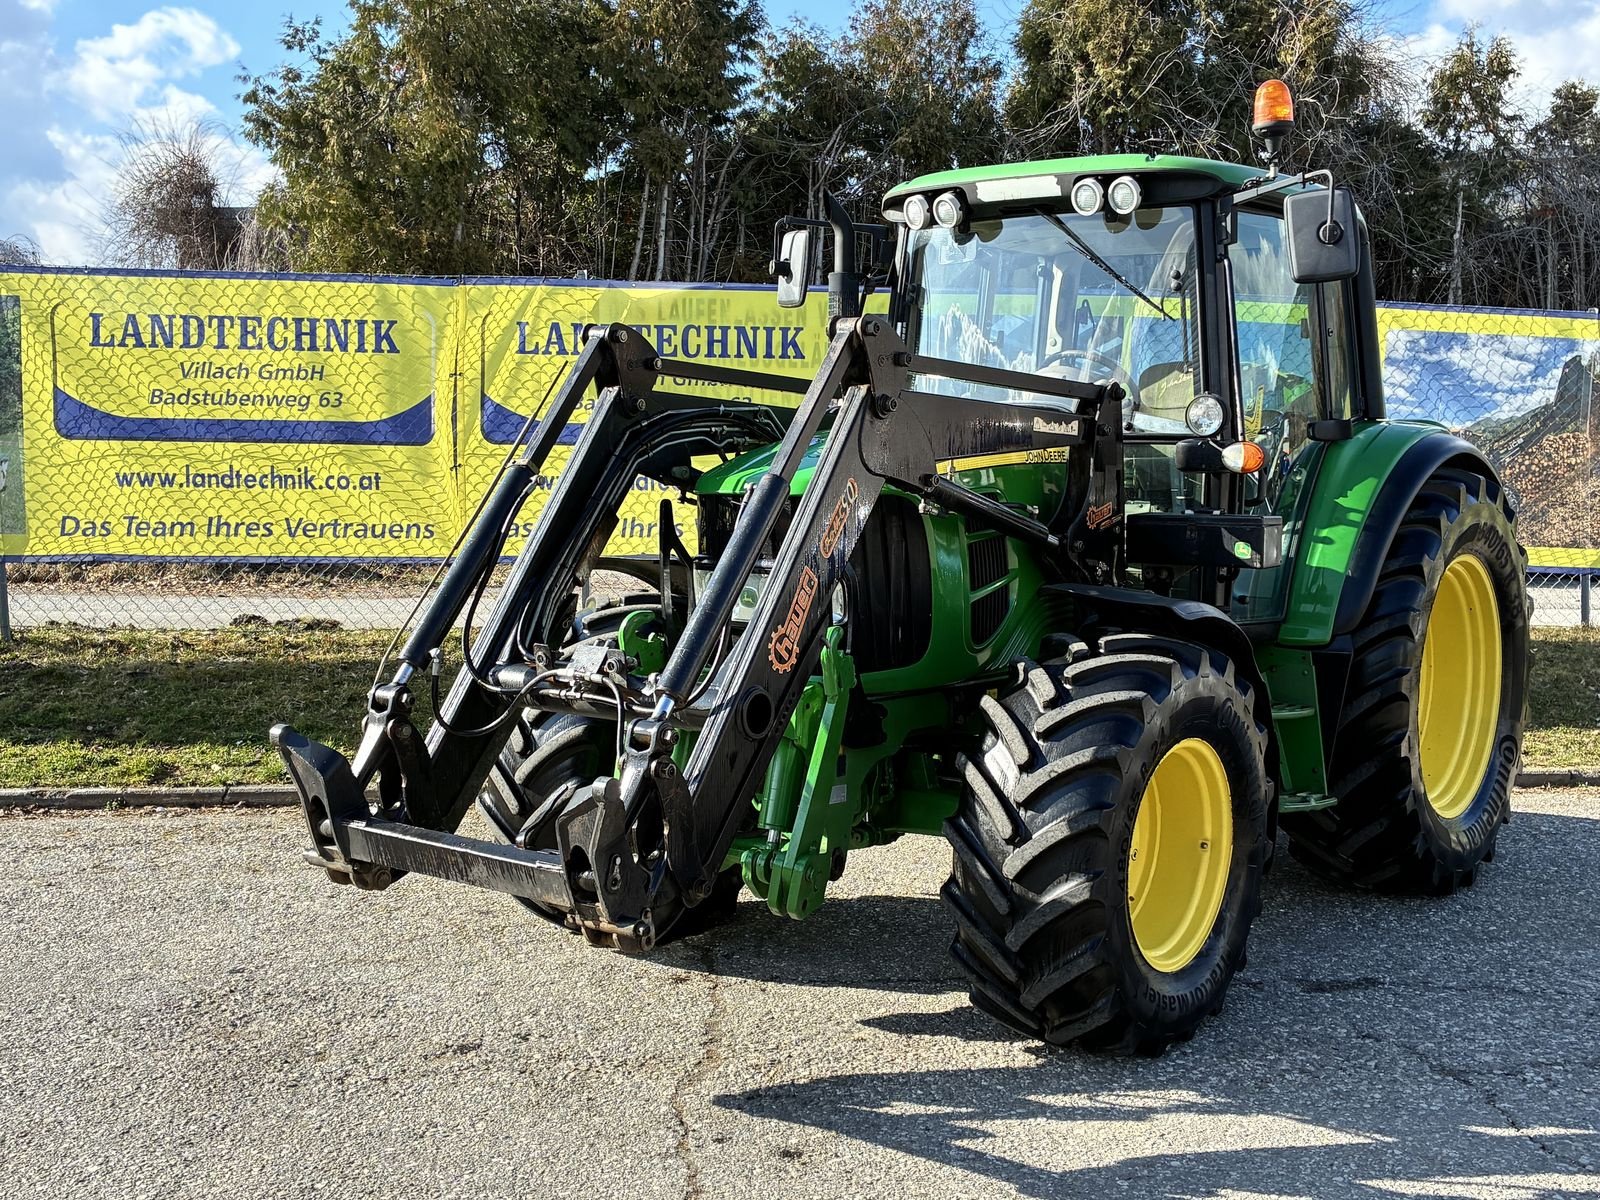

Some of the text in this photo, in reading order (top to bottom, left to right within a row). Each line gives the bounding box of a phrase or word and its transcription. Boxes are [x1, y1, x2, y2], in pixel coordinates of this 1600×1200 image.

[89, 313, 401, 353] LANDTECHNIK
[180, 362, 325, 381] Villach GmbH
[148, 389, 343, 411] Badstubenweg 63
[1024, 449, 1066, 462] JOHN DEERE
[116, 465, 381, 490] www.landtechnik.co.at
[60, 515, 435, 539] Das Team Ihres Vertrauens
[621, 517, 683, 538] Ihrs
[775, 573, 816, 661] hauer
[1463, 735, 1519, 850] Continental
